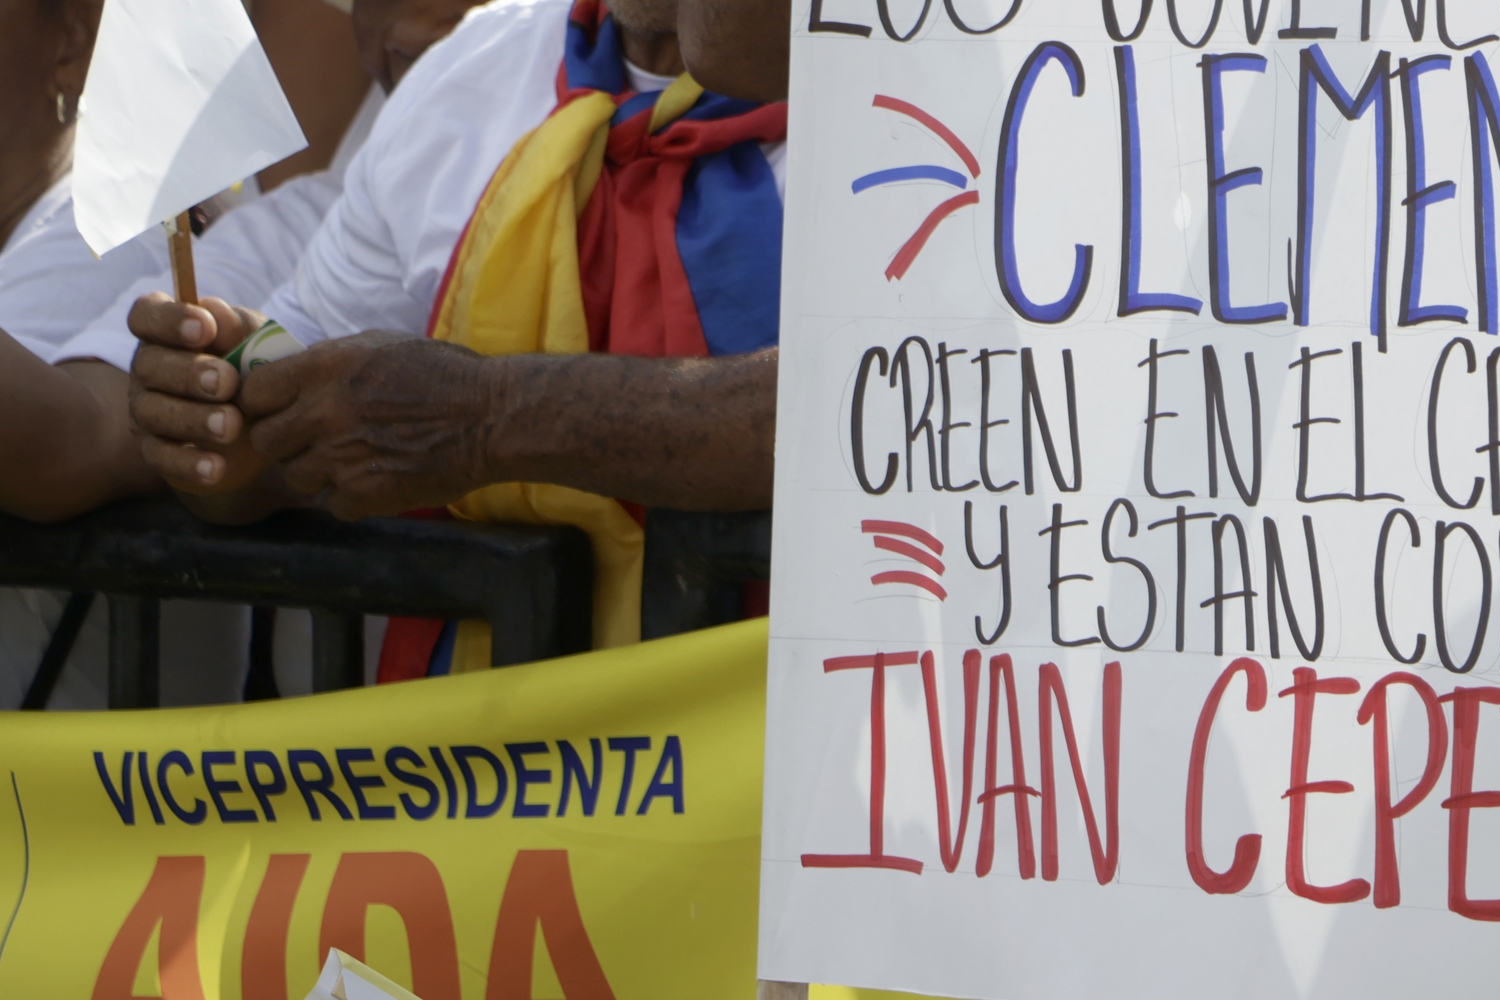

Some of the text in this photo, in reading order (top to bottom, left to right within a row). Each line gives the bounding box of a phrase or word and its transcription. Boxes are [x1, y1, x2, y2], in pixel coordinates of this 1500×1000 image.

[850, 335, 1082, 496] CREEN
[1137, 338, 1262, 507] EN
[1289, 341, 1405, 503] EL
[963, 500, 1012, 646] Y
[1038, 498, 1325, 662] ESTAN
[93, 735, 685, 826] VICEPRESIDENTA
[800, 648, 1123, 885] IVAN
[90, 849, 619, 1000] AIDA
